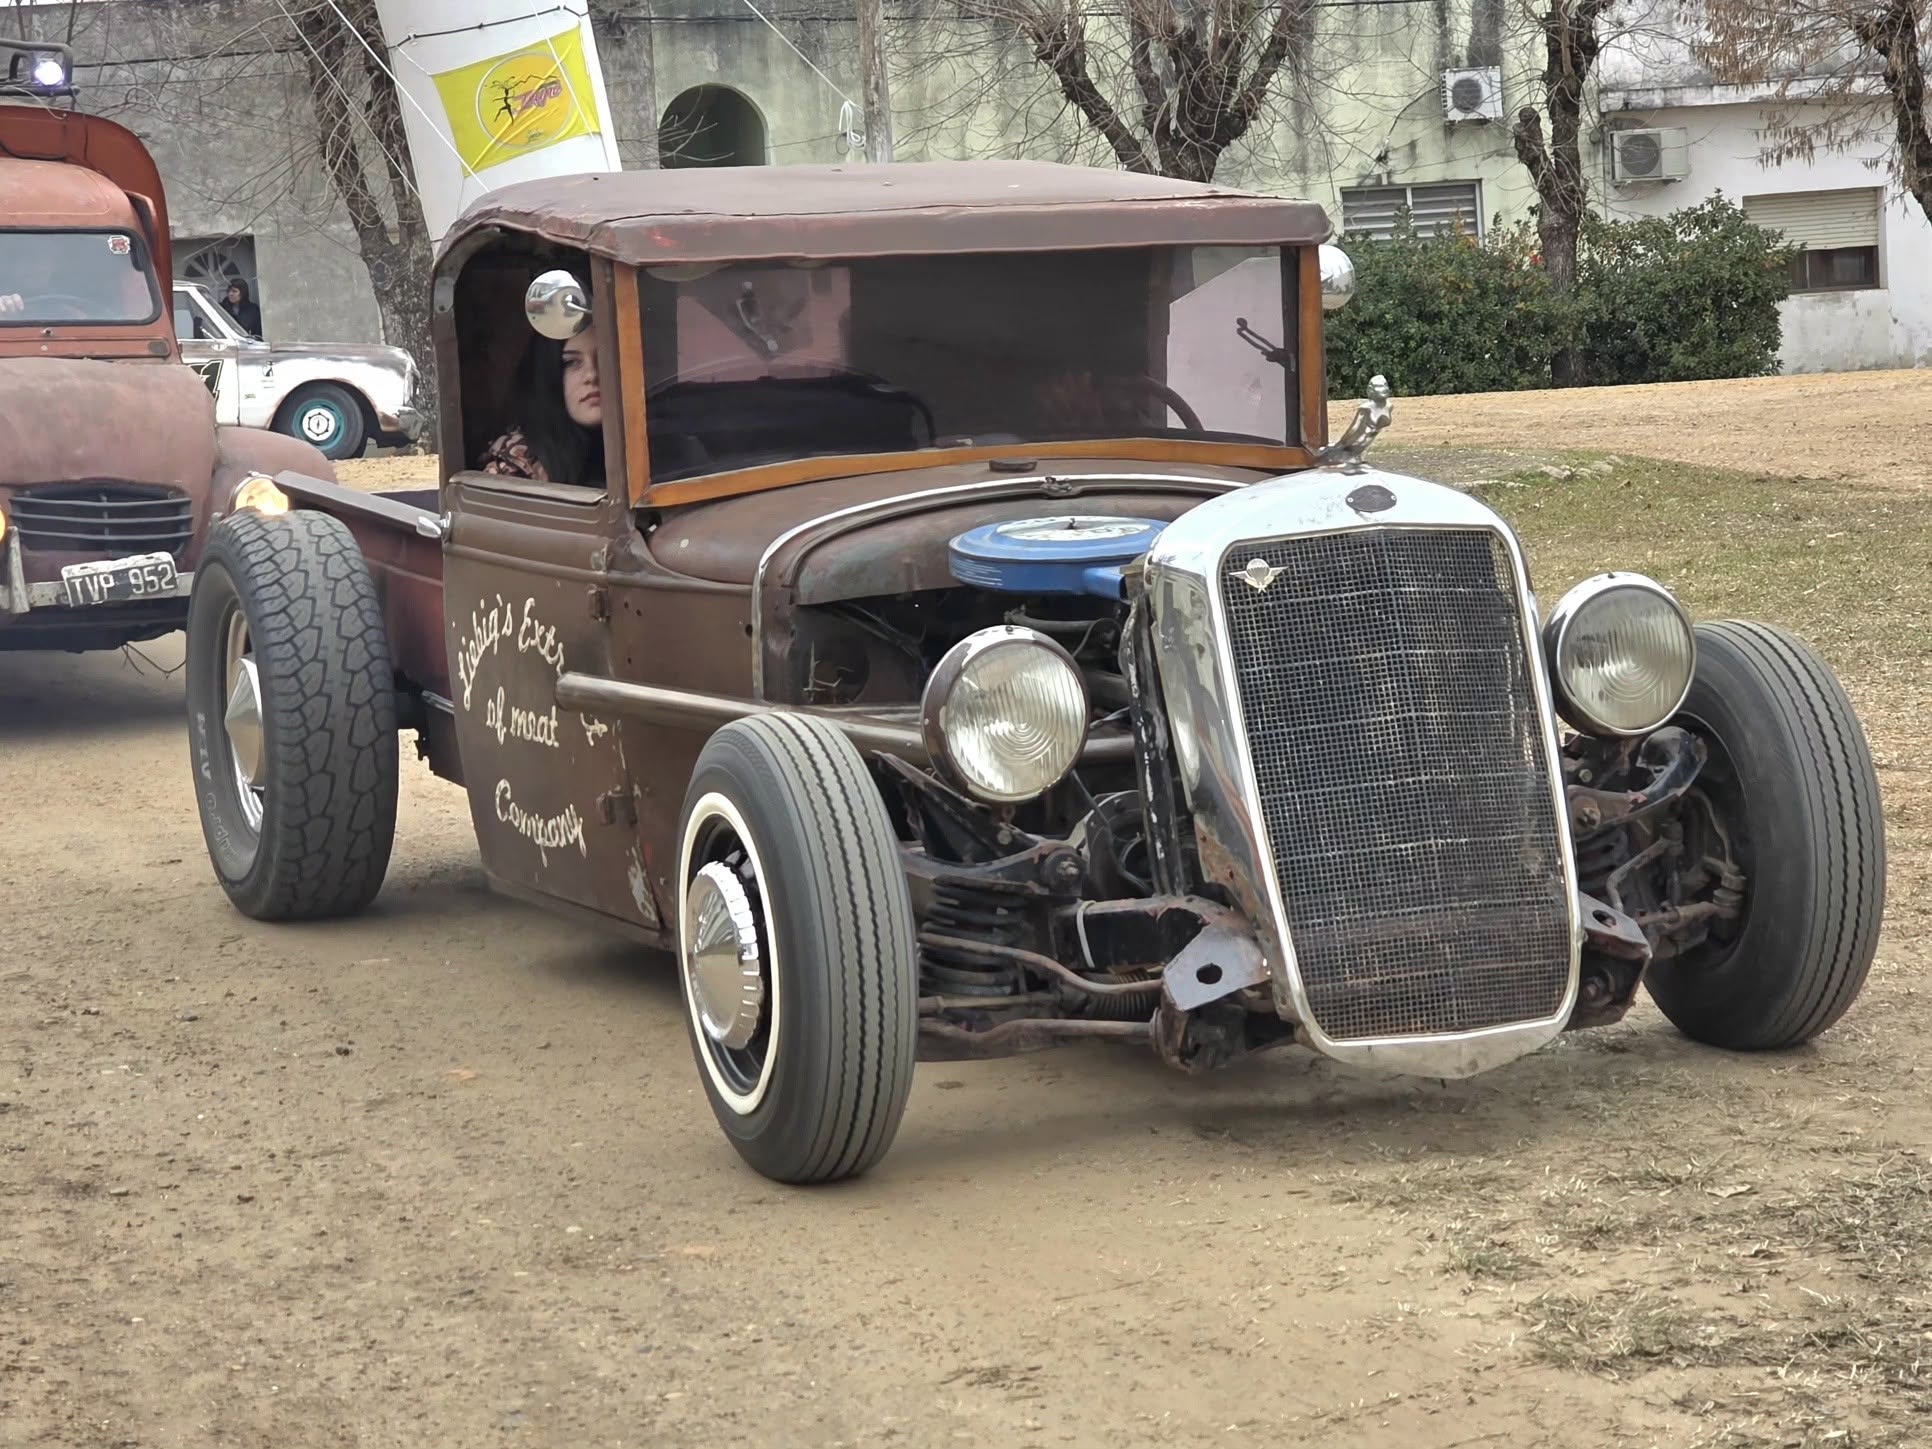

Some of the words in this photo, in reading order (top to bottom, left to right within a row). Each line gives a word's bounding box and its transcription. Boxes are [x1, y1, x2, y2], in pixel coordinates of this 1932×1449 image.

[129, 564, 174, 594] 952
[487, 686, 507, 745] of
[511, 705, 559, 747] meat
[495, 779, 587, 867] Company
